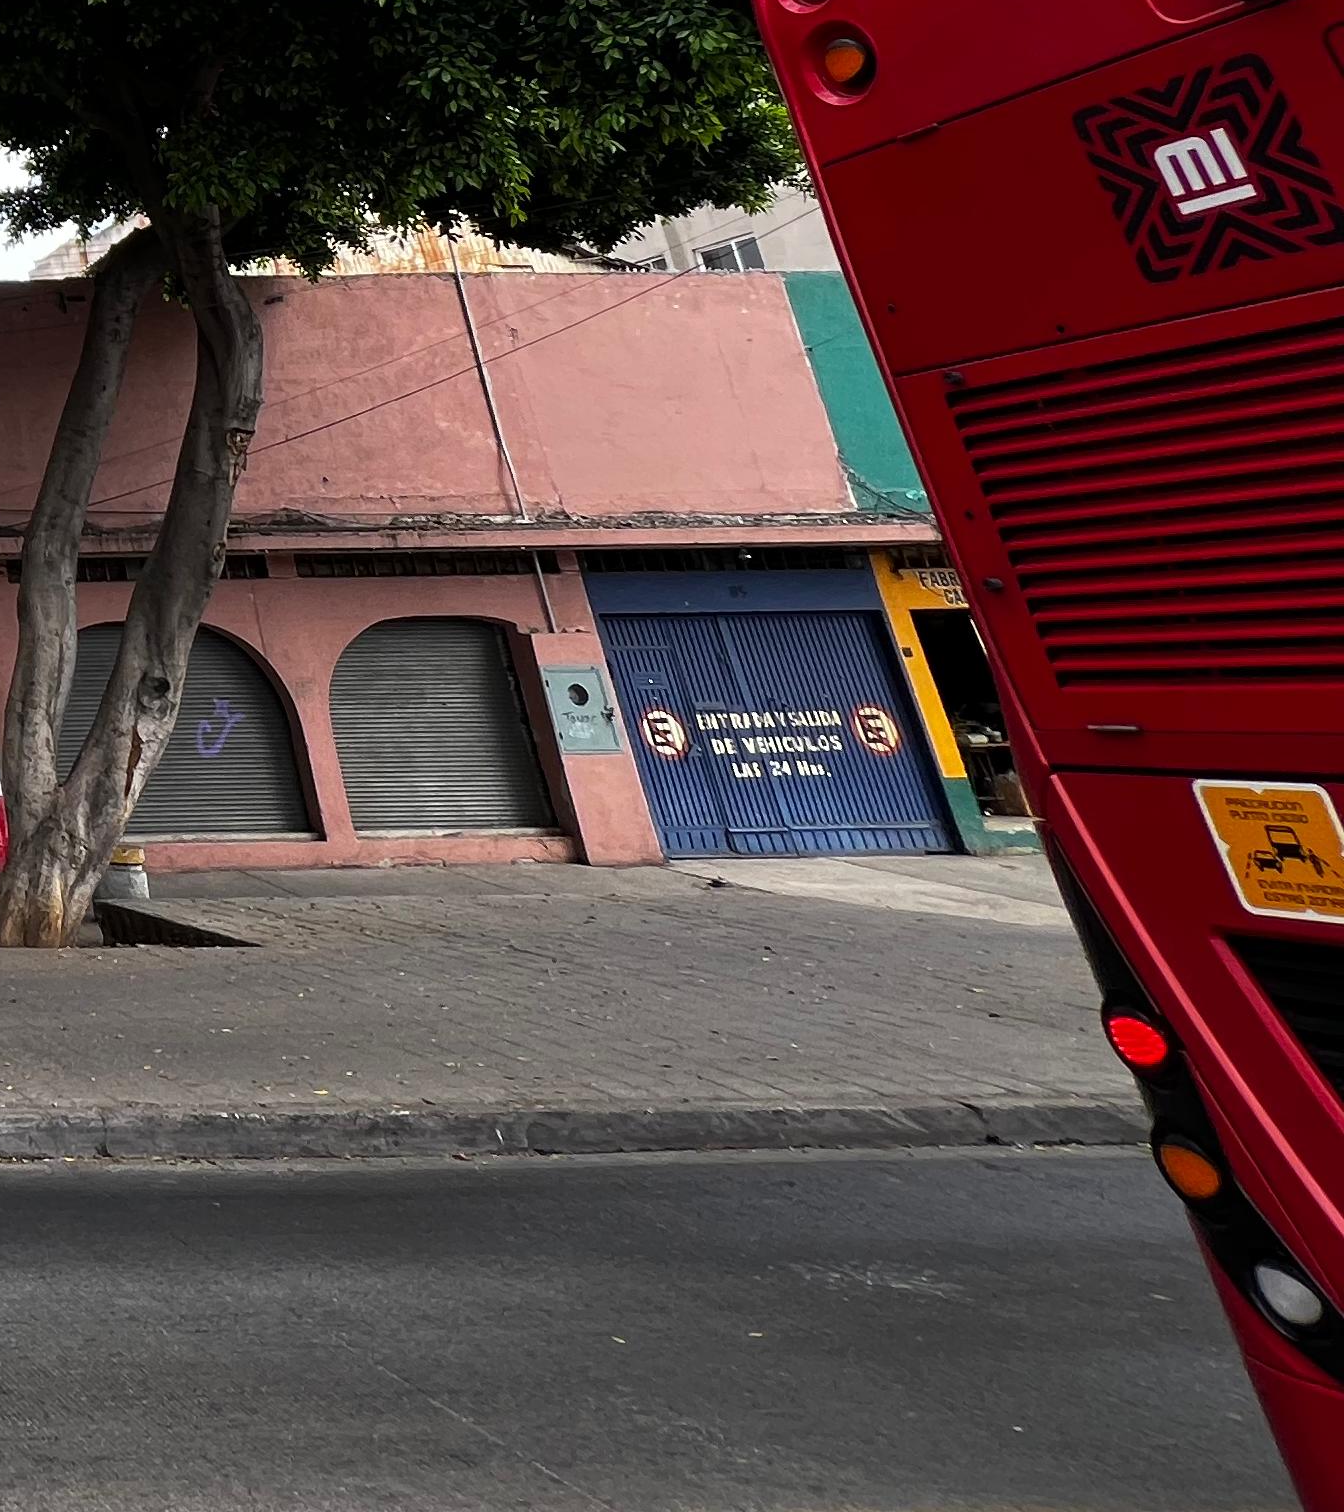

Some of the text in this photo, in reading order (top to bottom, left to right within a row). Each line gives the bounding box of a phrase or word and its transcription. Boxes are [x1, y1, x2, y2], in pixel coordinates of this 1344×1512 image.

[918, 570, 962, 588] FABR
[943, 589, 968, 605] CA
[695, 710, 842, 730] ENTRADA Y SALIDA
[711, 735, 843, 755] DE VEHICULOS
[732, 761, 762, 778] LAS
[769, 760, 792, 777] 24
